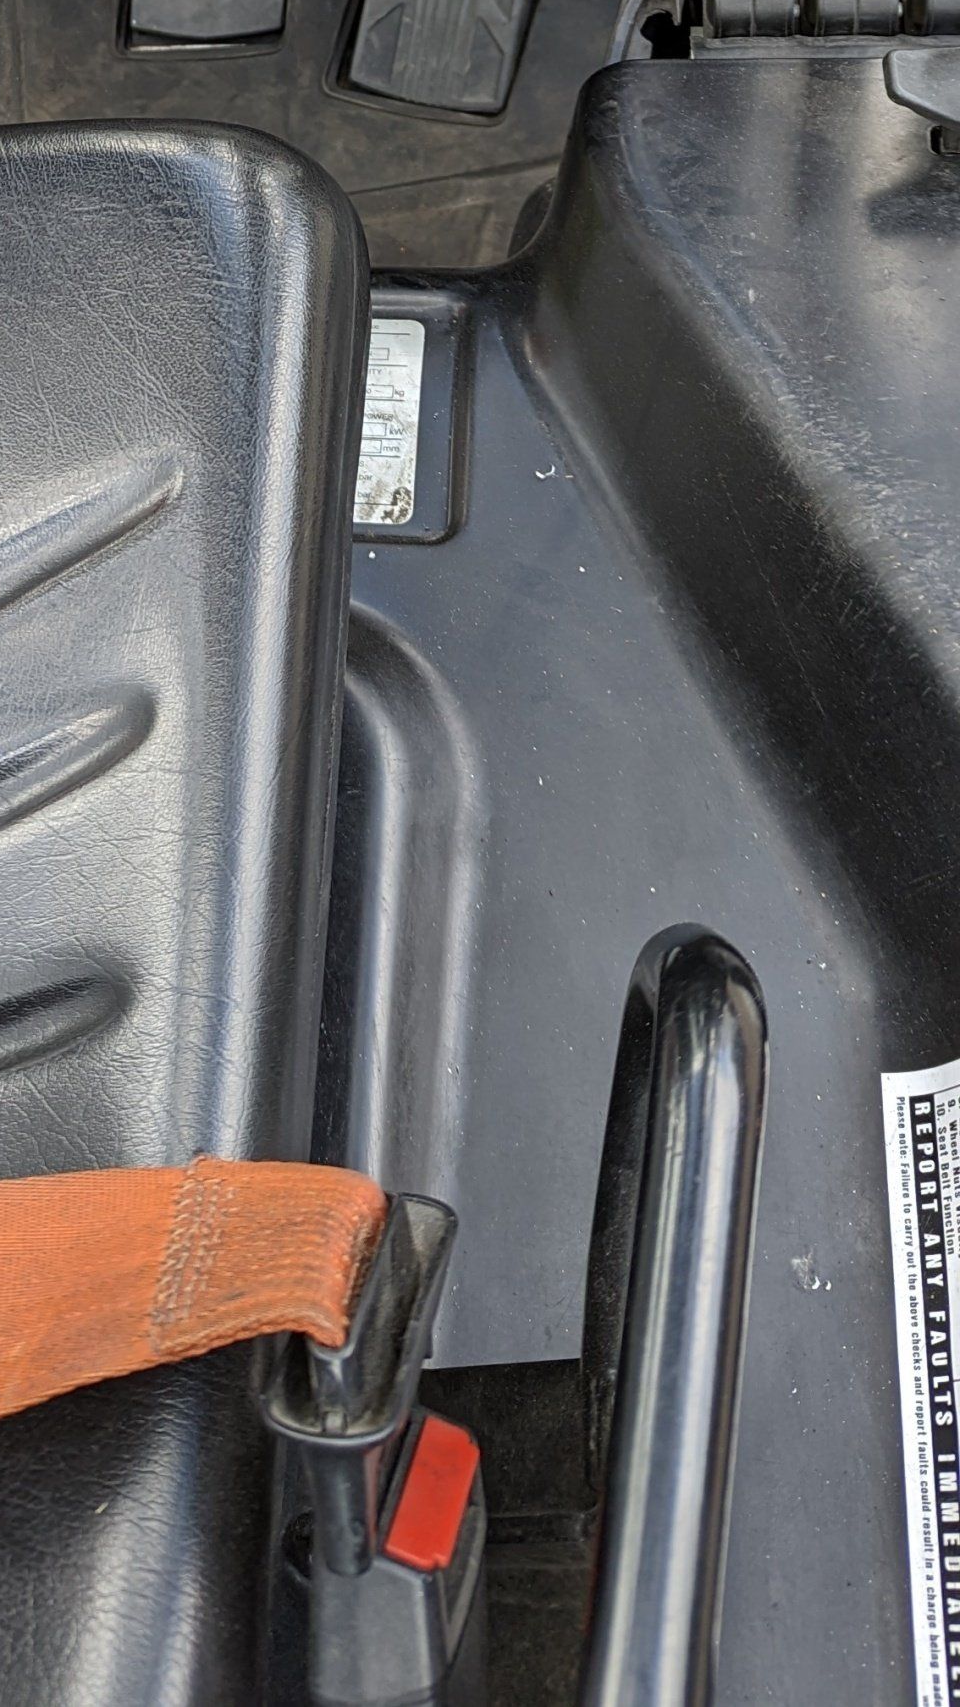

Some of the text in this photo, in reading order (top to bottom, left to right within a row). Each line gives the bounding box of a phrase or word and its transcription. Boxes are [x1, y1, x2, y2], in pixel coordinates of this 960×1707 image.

[365, 412, 394, 422] OWER
[947, 1099, 956, 1112] 9.
[948, 1120, 960, 1161] Wheel
[913, 1101, 939, 1212] REPORT
[936, 1102, 956, 1256] 10. Seat Belt Function
[923, 1232, 944, 1288] ANY
[896, 1096, 944, 1707] Please note: Failure to carry out the above checks and report faults could result in a charge being made
[927, 1309, 953, 1427] FAULTS
